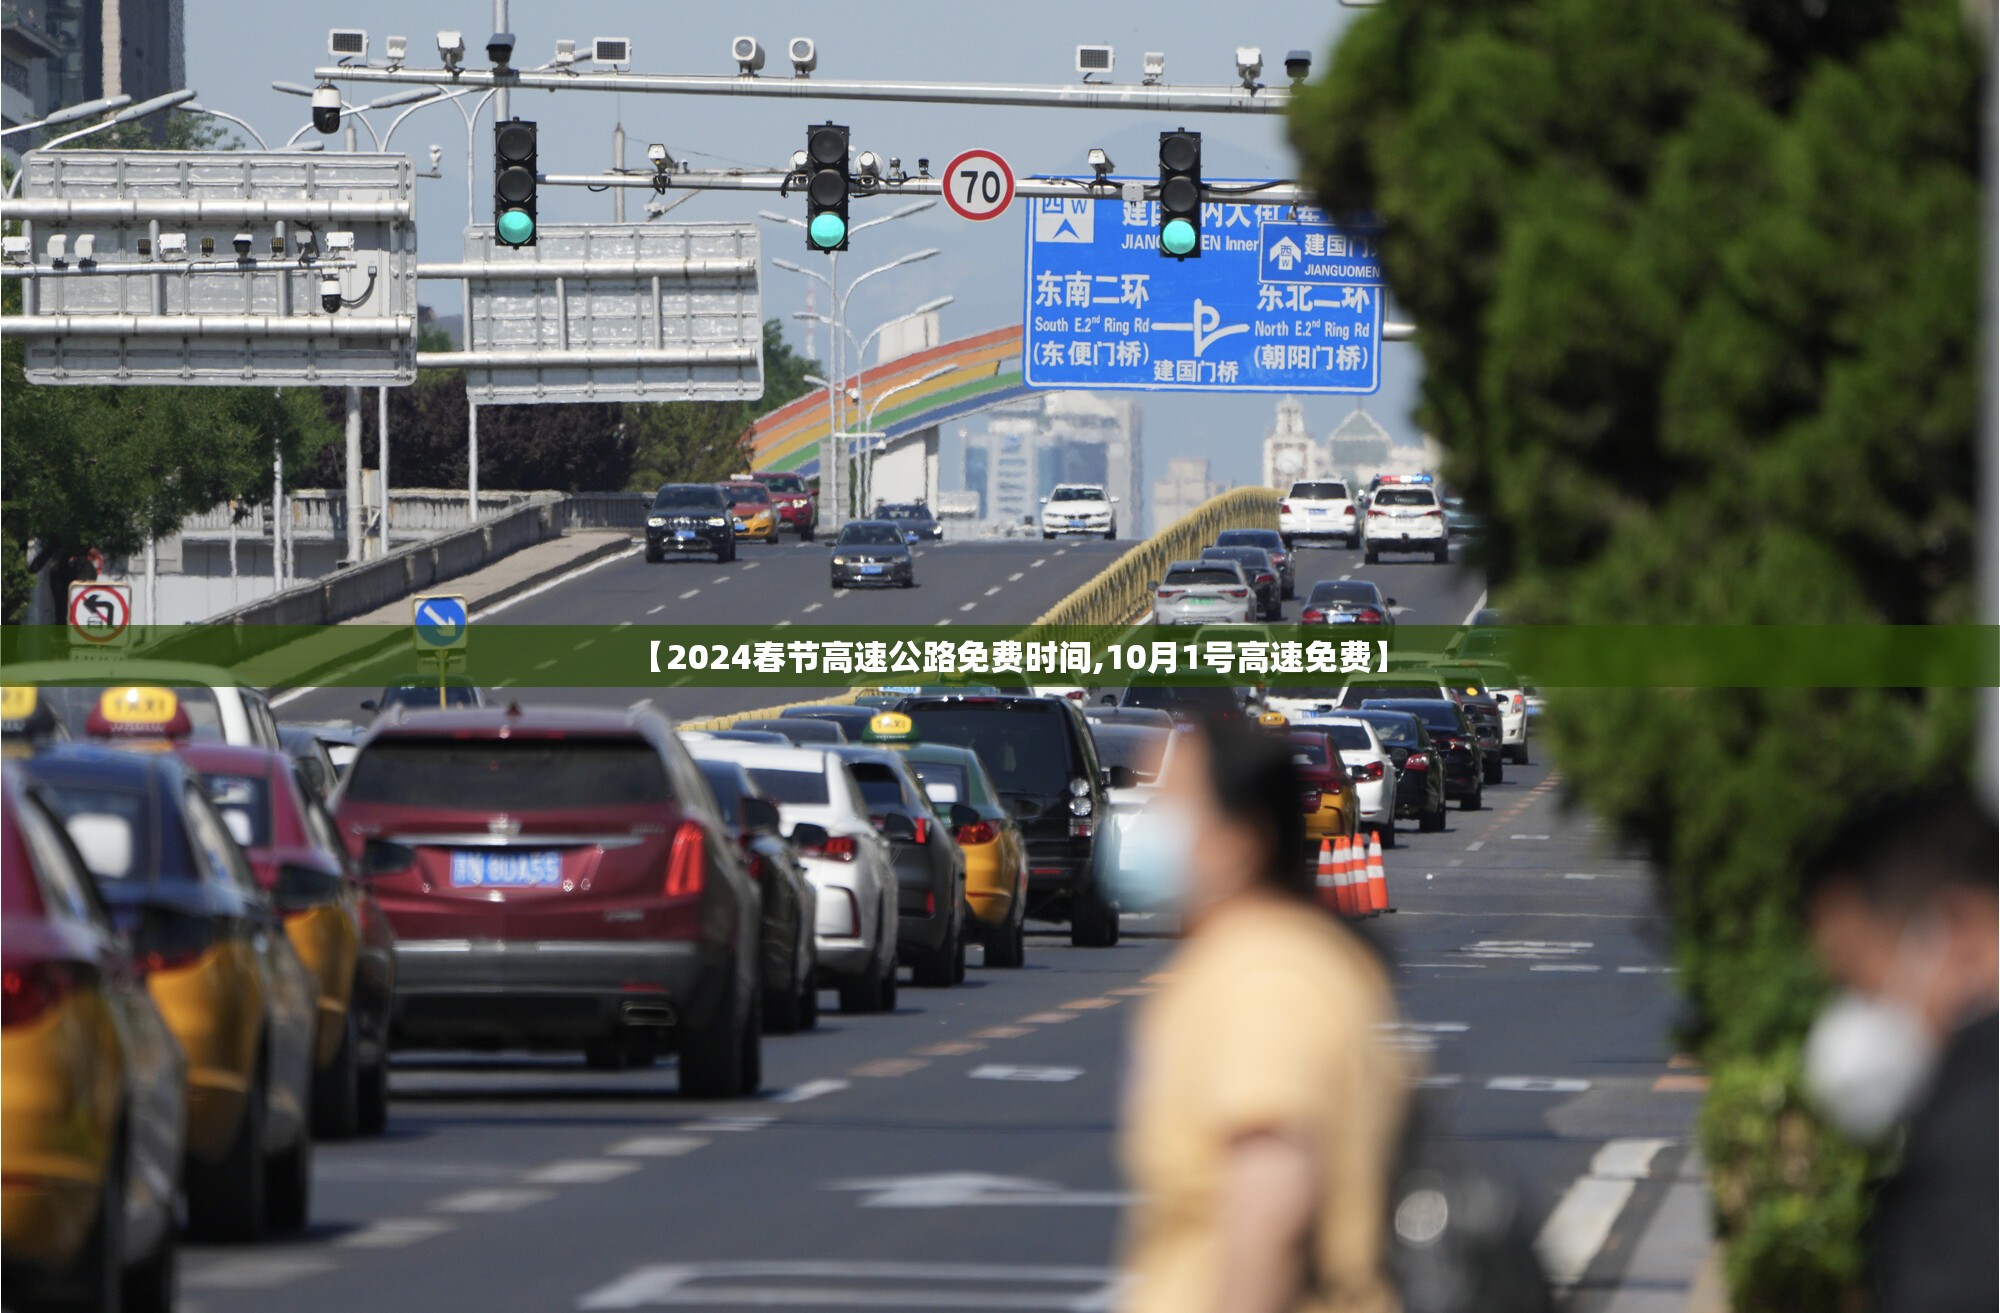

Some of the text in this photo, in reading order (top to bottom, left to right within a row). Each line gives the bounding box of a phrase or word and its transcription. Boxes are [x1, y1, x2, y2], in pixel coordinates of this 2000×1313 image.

[961, 170, 1000, 204] 70
[1071, 199, 1087, 214] W
[1225, 235, 1260, 251] Inner
[1281, 246, 1292, 257] 西
[1281, 260, 1290, 268] W
[1304, 264, 1380, 278] JIANGUOMEN
[1035, 270, 1150, 309] 东南二环
[1035, 316, 1069, 332] South
[1104, 317, 1130, 336] Ring
[1134, 317, 1150, 333] Rd
[1255, 320, 1289, 337] North
[1325, 322, 1350, 341] Ring
[1354, 322, 1370, 338] Rd
[1034, 340, 1149, 367] (东便门桥)
[1254, 344, 1368, 371] (朝阳门桥)
[1153, 359, 1239, 383] 建国门桥
